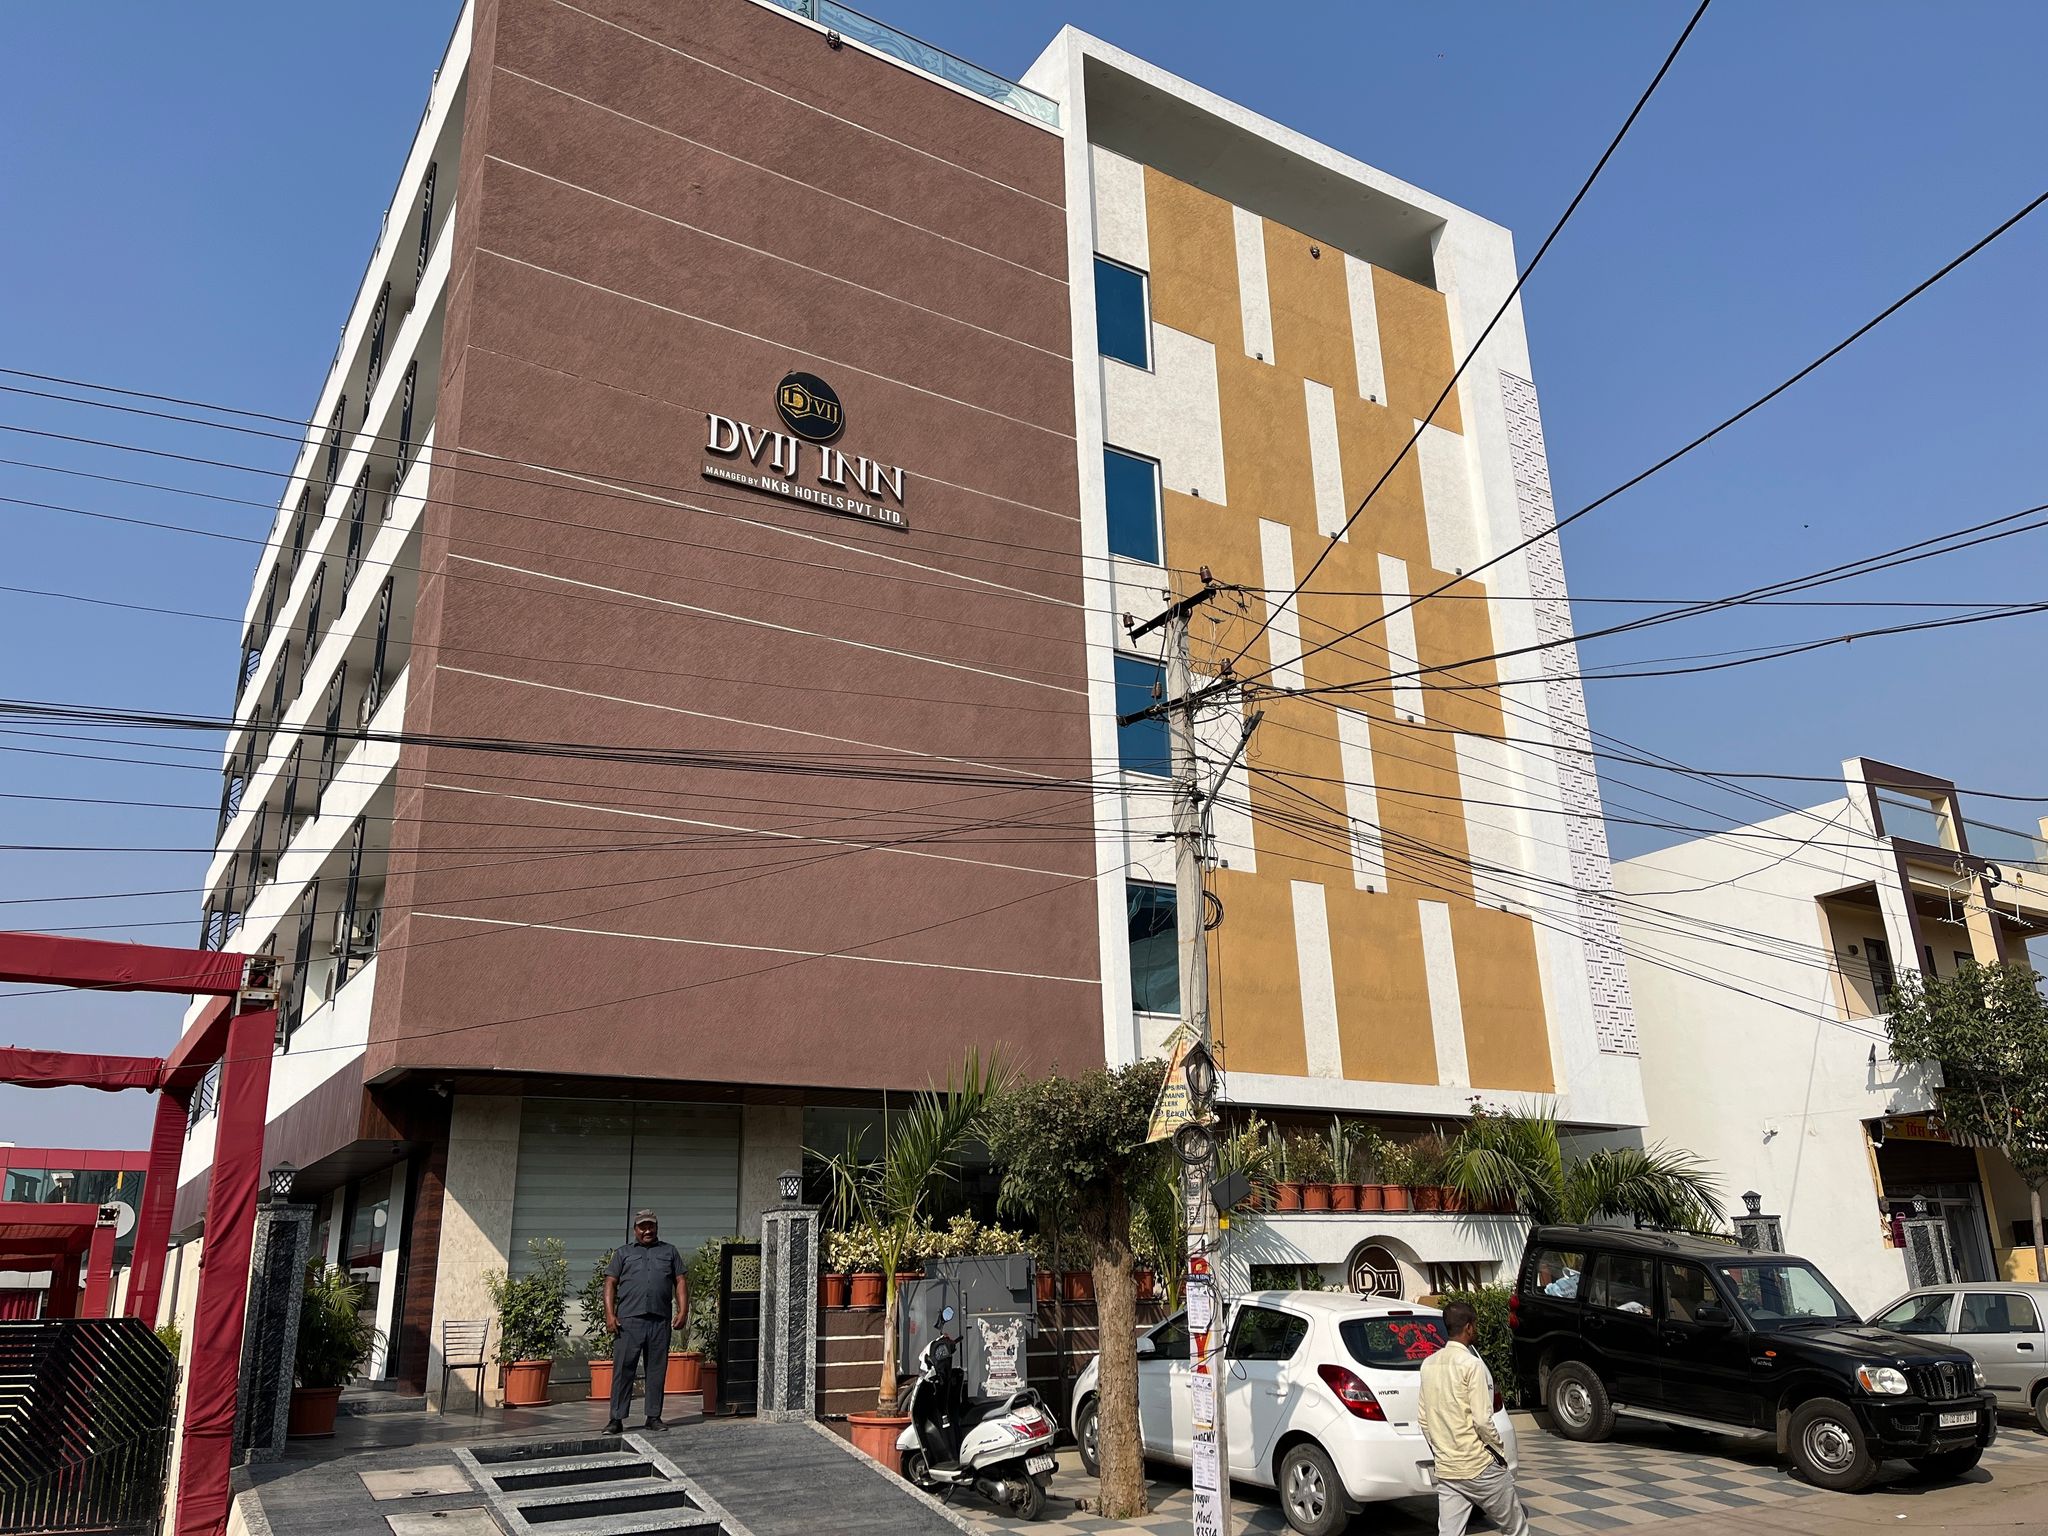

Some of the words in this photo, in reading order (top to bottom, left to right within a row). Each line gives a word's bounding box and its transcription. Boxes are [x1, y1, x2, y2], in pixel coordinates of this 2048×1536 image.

[707, 412, 799, 476] DVIJ
[819, 445, 904, 501] INN
[705, 465, 747, 483] MANAGED
[748, 477, 758, 486] BY
[761, 476, 790, 494] NKB
[795, 485, 844, 508] HOTELS
[847, 499, 876, 518] PVT.
[879, 507, 904, 525] LTD.
